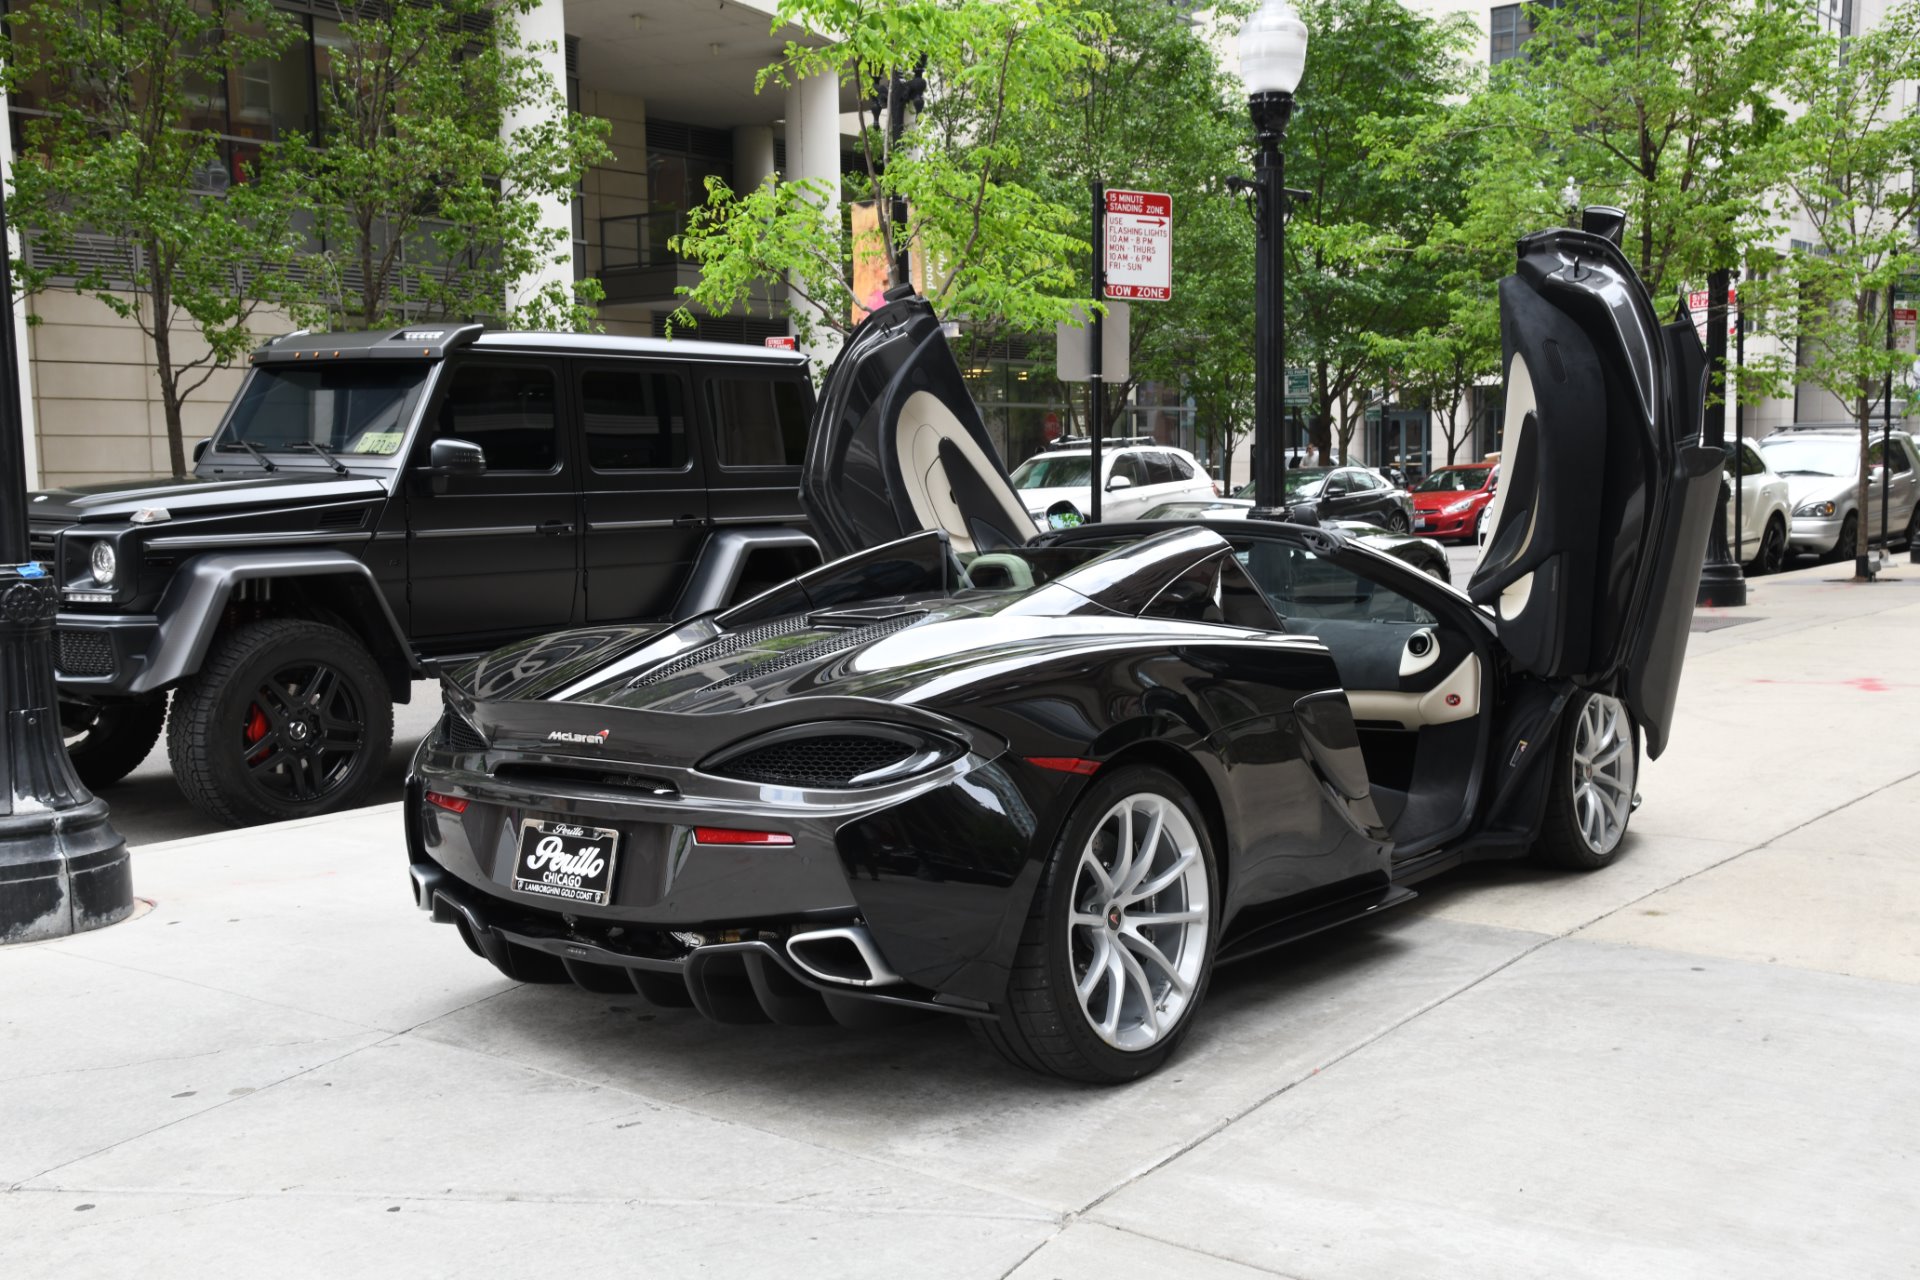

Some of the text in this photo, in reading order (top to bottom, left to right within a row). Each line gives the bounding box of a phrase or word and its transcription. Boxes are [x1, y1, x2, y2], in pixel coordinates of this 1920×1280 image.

[1110, 193, 1144, 204] 15 MINUTE
[1110, 203, 1164, 215] STANDING ZONE
[1110, 217, 1123, 225] USE
[1110, 226, 1168, 238] FLASHING LIGHTS
[1109, 244, 1125, 252] MON
[1133, 245, 1156, 254] THURS
[1117, 253, 1128, 261] AM
[1142, 255, 1152, 263] PM
[1109, 262, 1121, 270] FRI
[1127, 262, 1142, 271] SUN
[1110, 285, 1165, 298] TOW ZONE
[547, 731, 603, 744] McLaren
[552, 823, 584, 836] Perillo
[527, 836, 605, 878] Perillo
[543, 871, 582, 888] CHICAGO
[525, 883, 593, 901] LAMBORGHINI GOLD COAST
